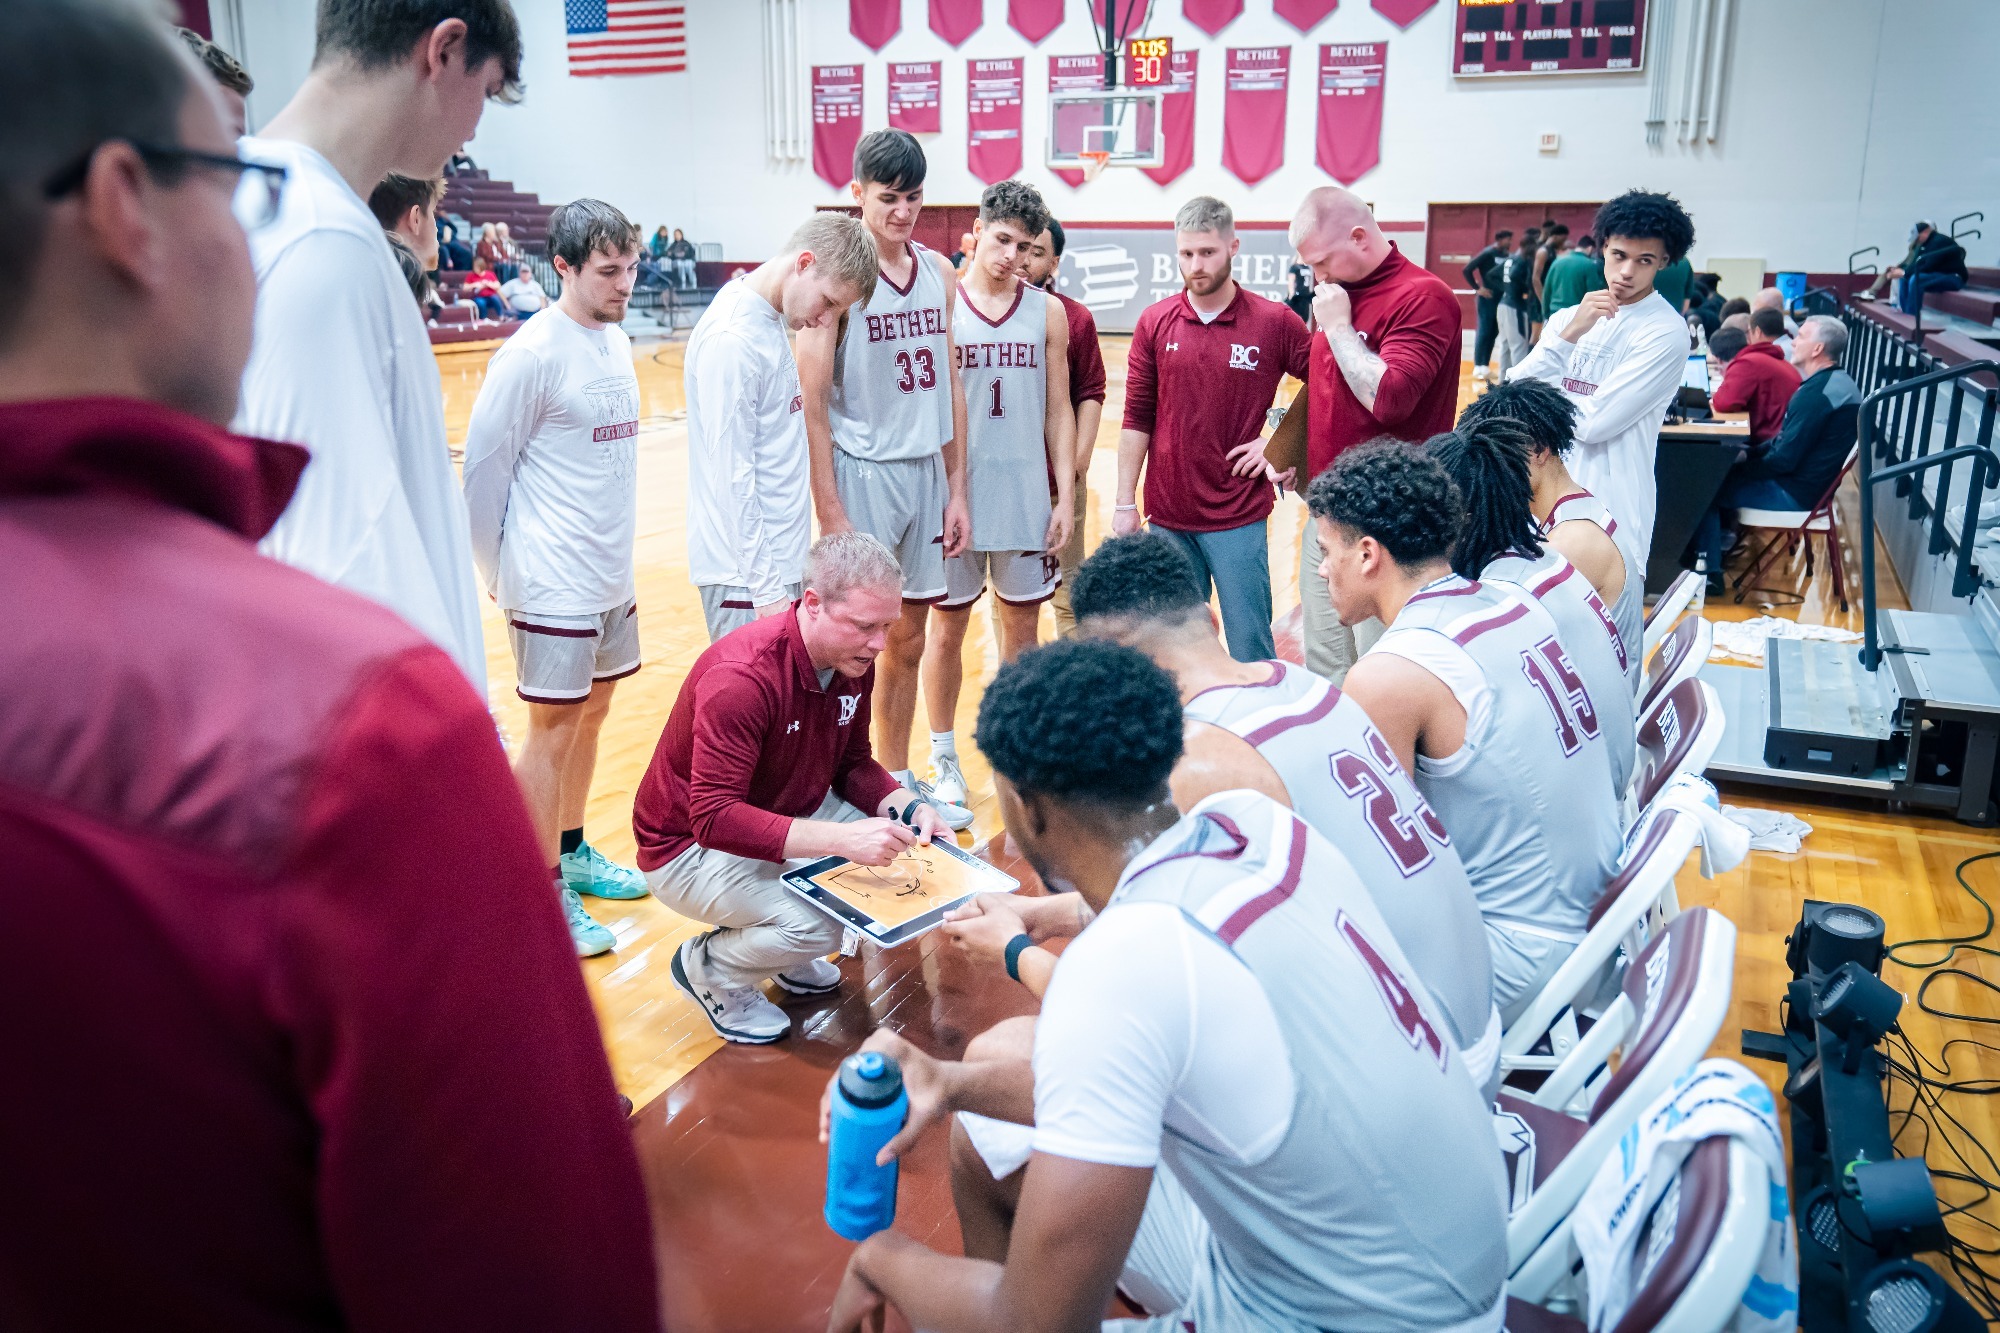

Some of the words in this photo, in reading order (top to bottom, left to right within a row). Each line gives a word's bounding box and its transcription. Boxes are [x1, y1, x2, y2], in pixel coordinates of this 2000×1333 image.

[1462, 32, 1487, 42] FOULS
[1522, 29, 1552, 40] PLAYER
[1609, 26, 1636, 36] FOULS
[1131, 39, 1168, 57] 17:05
[1236, 49, 1281, 61] BETHEL
[1330, 45, 1377, 57] BETHEL
[895, 64, 933, 75] BETHEL
[975, 61, 1016, 72] BETHEL
[1057, 57, 1099, 68] BETHEL
[1133, 57, 1162, 83] 30
[819, 66, 856, 78] BETHEL
[1151, 253, 1290, 285] BHEL
[865, 308, 947, 344] BETHEL
[1229, 344, 1260, 366] BC
[895, 346, 937, 394] 33
[989, 377, 1006, 419] 1
[1519, 634, 1600, 759] 15
[1335, 908, 1449, 1074] 4
